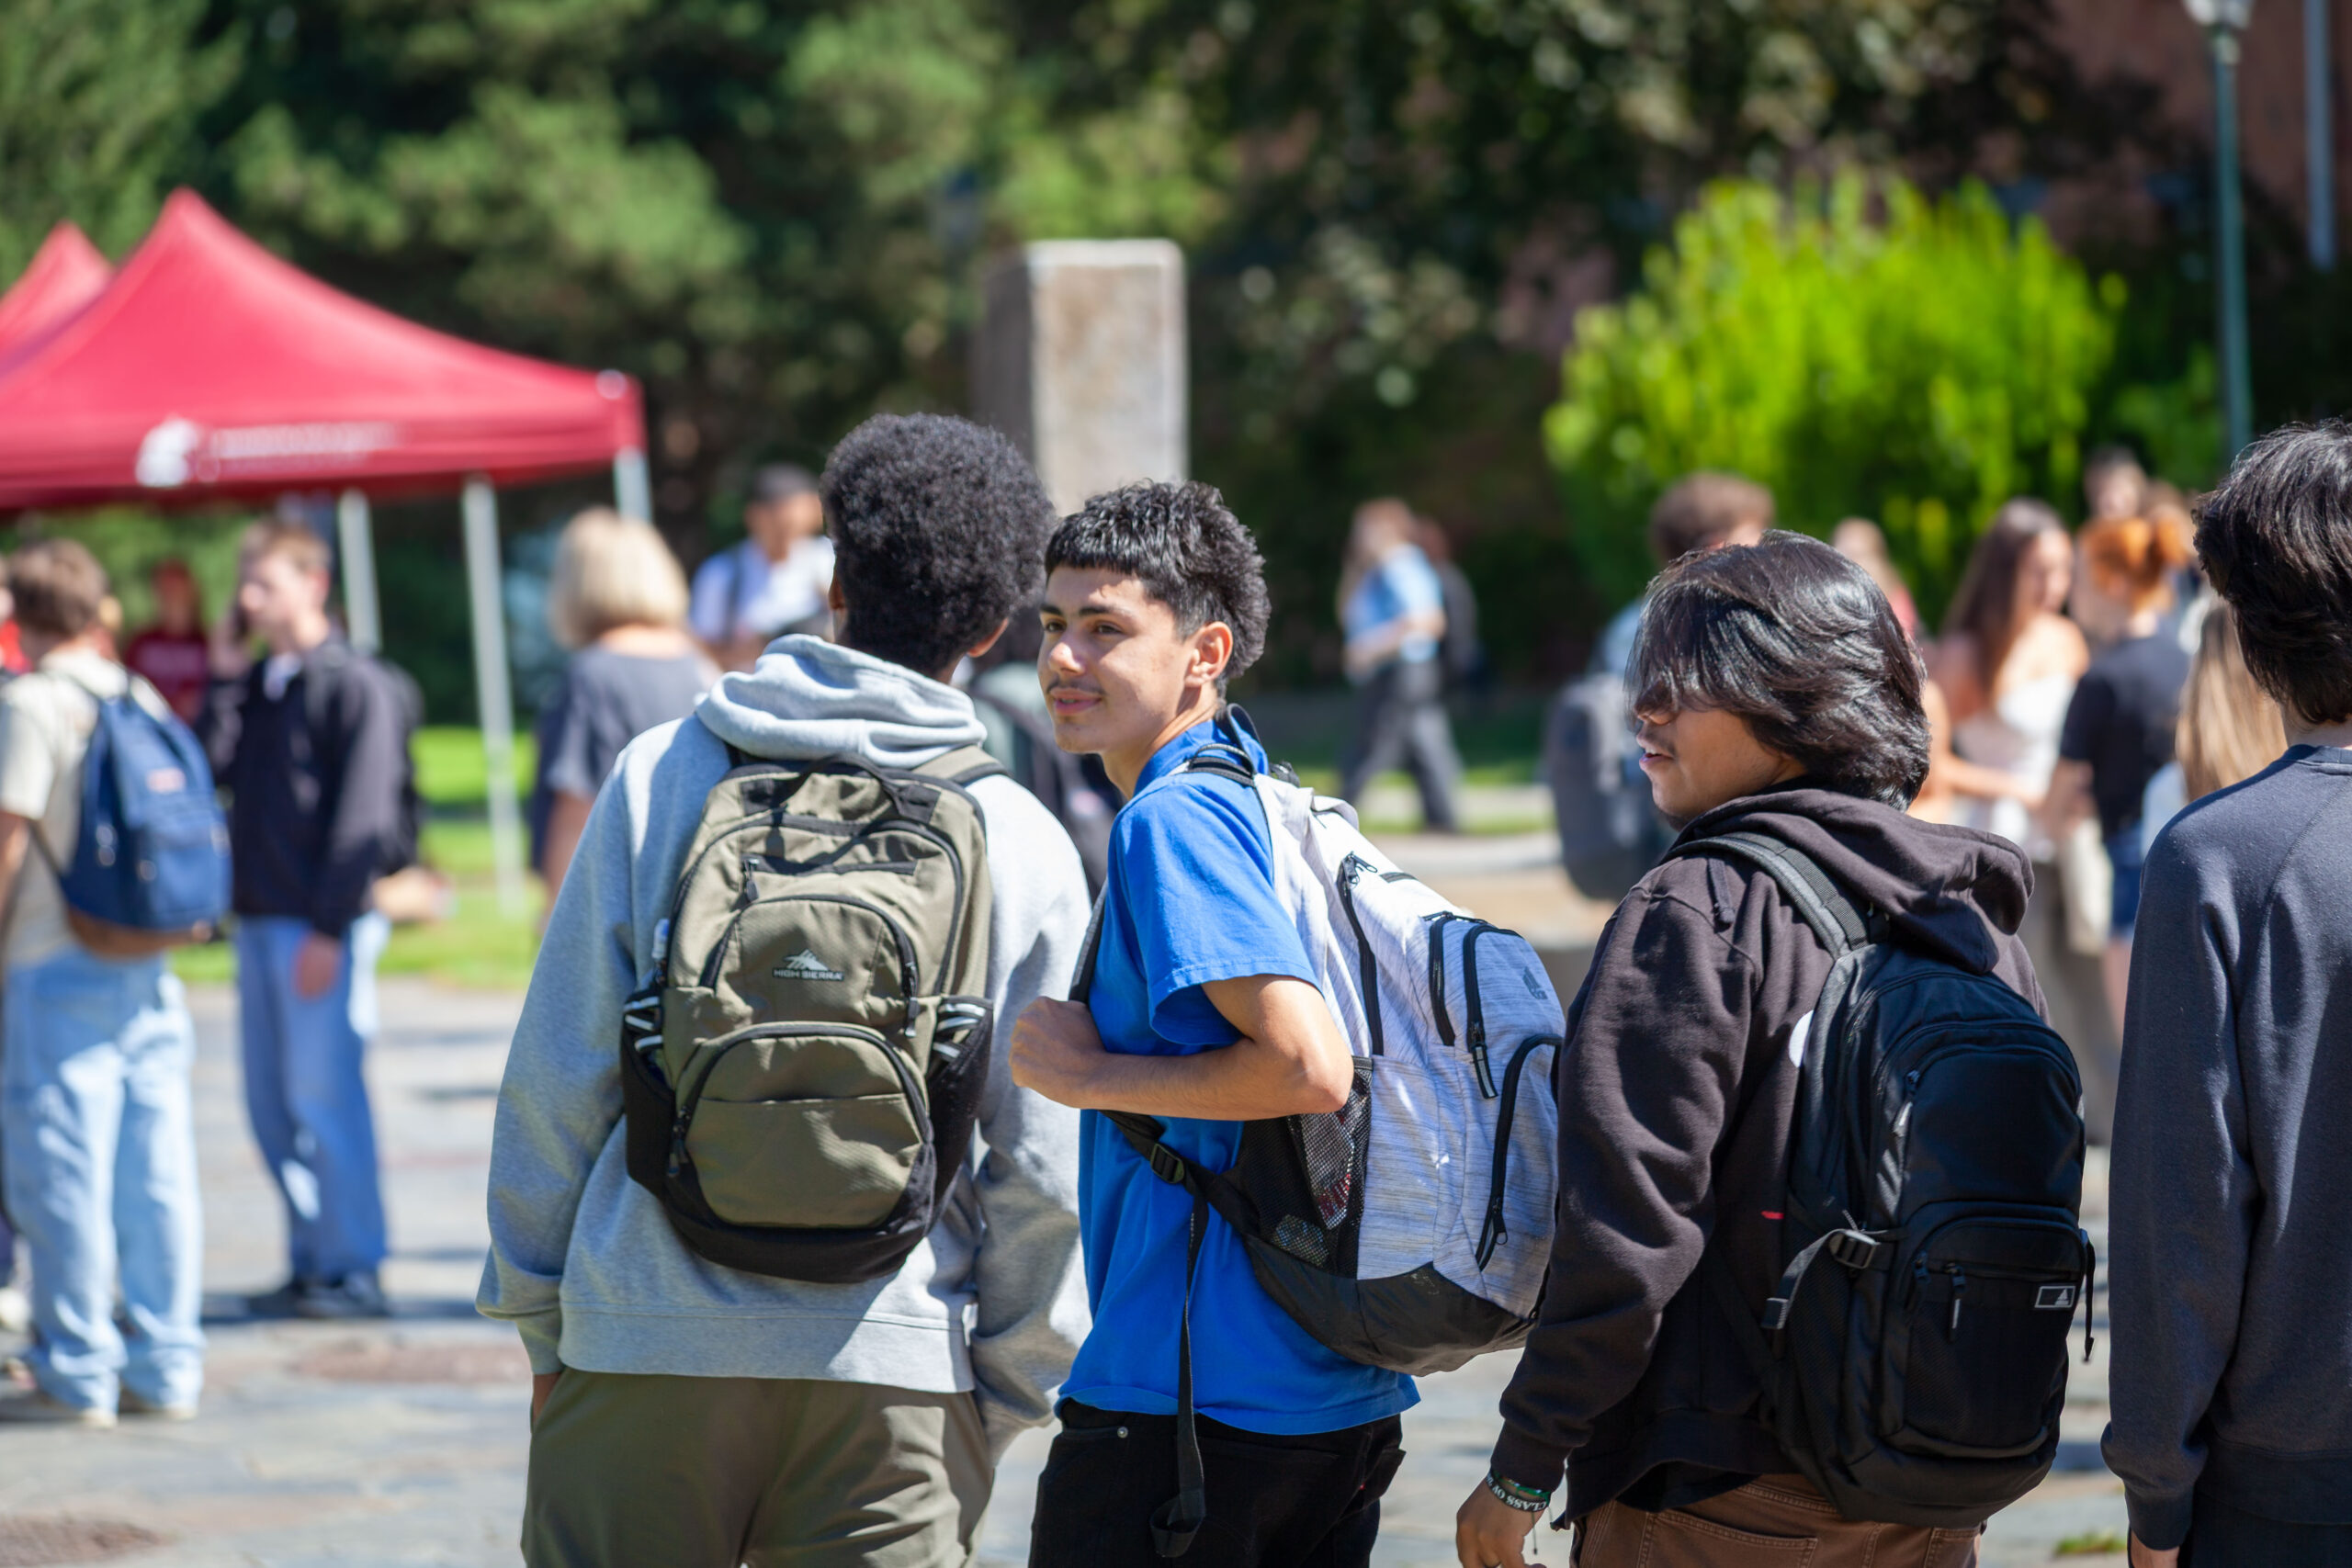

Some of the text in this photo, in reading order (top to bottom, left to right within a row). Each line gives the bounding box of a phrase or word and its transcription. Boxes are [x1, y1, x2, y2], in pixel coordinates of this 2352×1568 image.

[774, 969, 842, 980] HIGH SIERRA
[1506, 1495, 1546, 1511] CLASS
